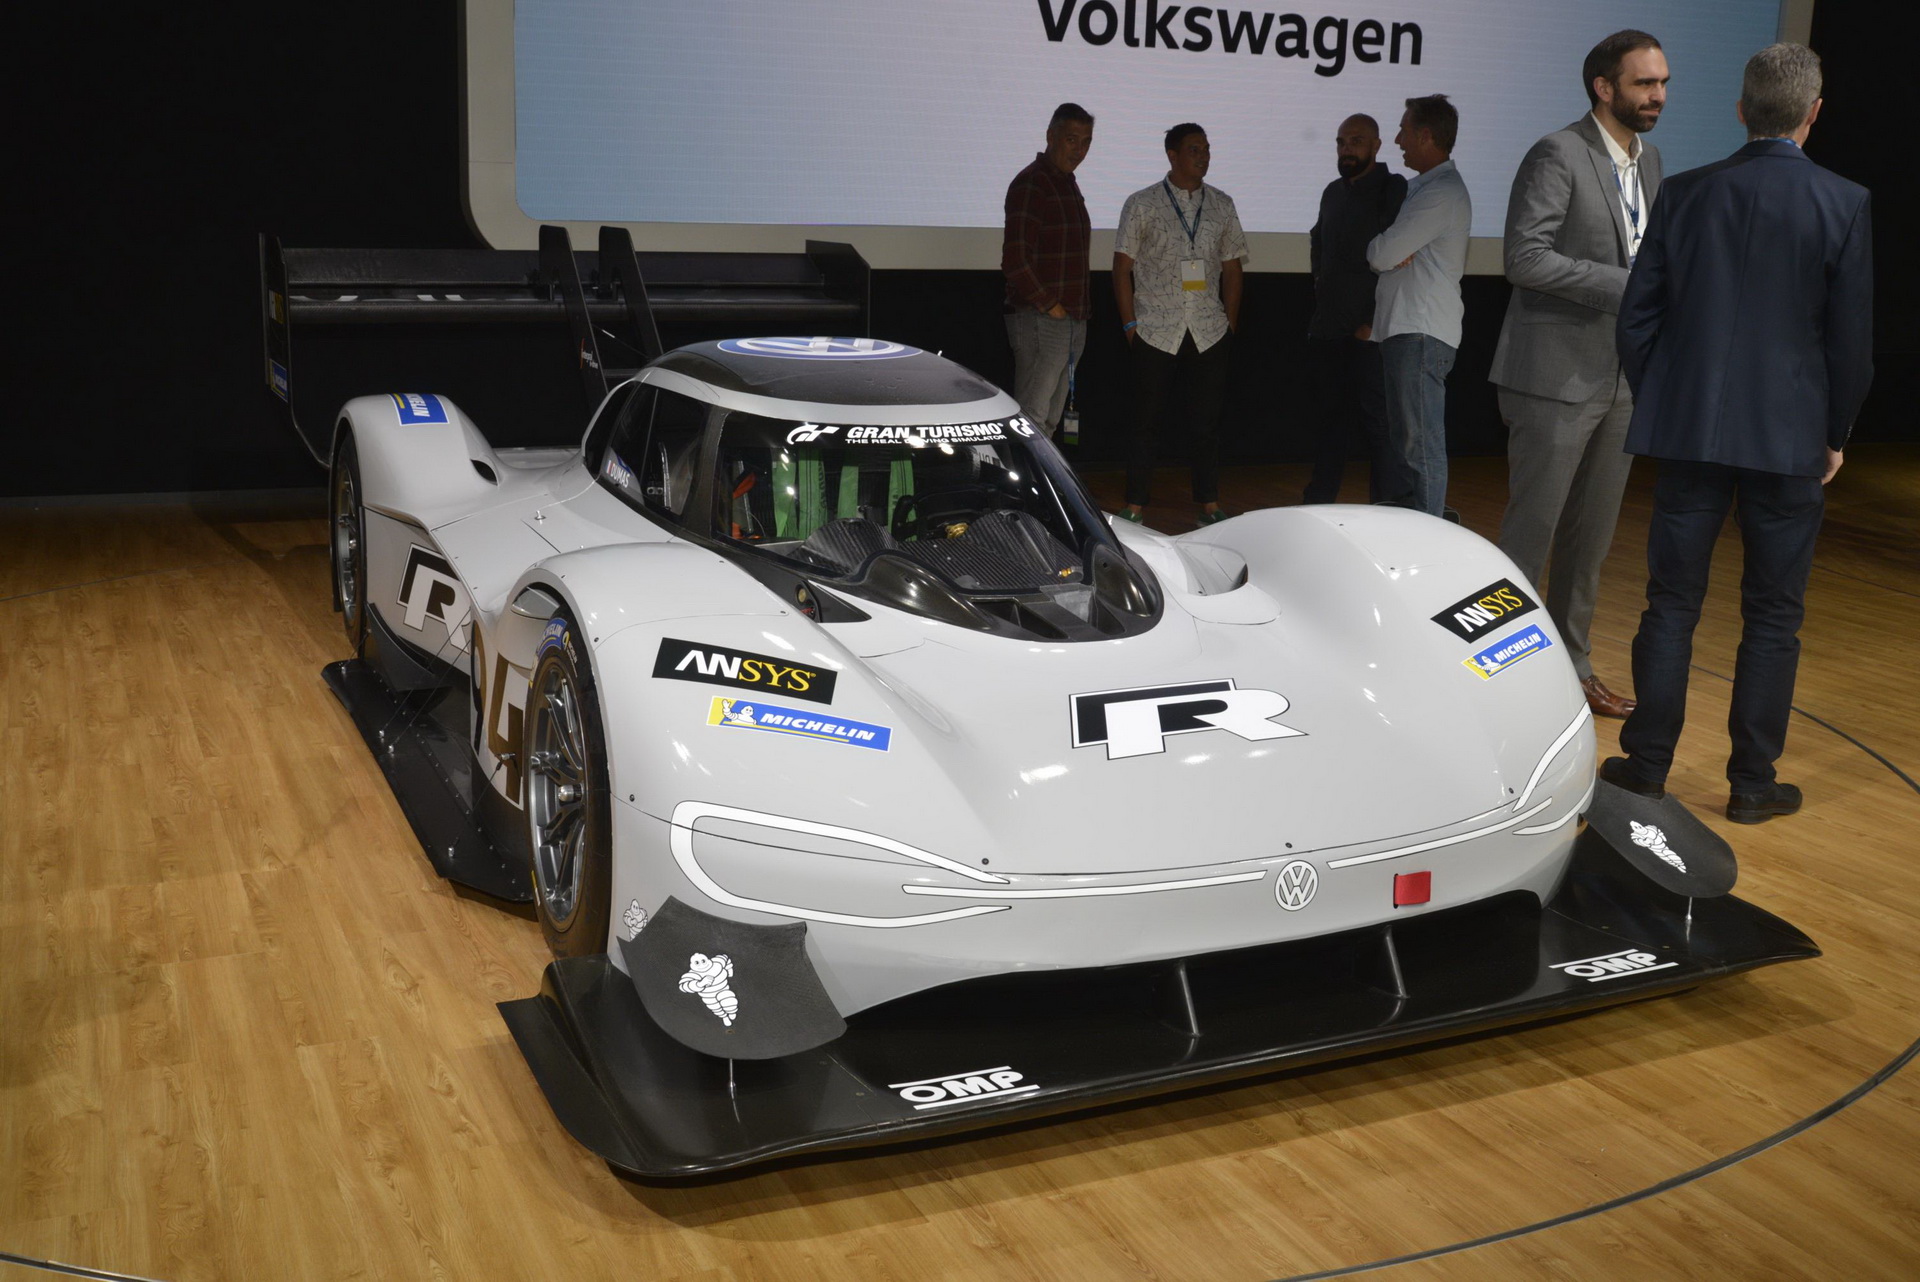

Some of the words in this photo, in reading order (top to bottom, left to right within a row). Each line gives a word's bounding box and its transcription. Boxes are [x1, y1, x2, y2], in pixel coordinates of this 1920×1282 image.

[1038, 0, 1424, 77] Volkswagen
[846, 426, 910, 439] GRAN
[610, 463, 631, 488] DUMAS
[1453, 587, 1523, 633] ANSYS
[1493, 632, 1542, 663] MICHELIN
[675, 649, 811, 692] ANSYS
[760, 712, 876, 741] MICHELIN
[1564, 952, 1657, 978] OMP
[899, 1070, 1024, 1103] OMP
